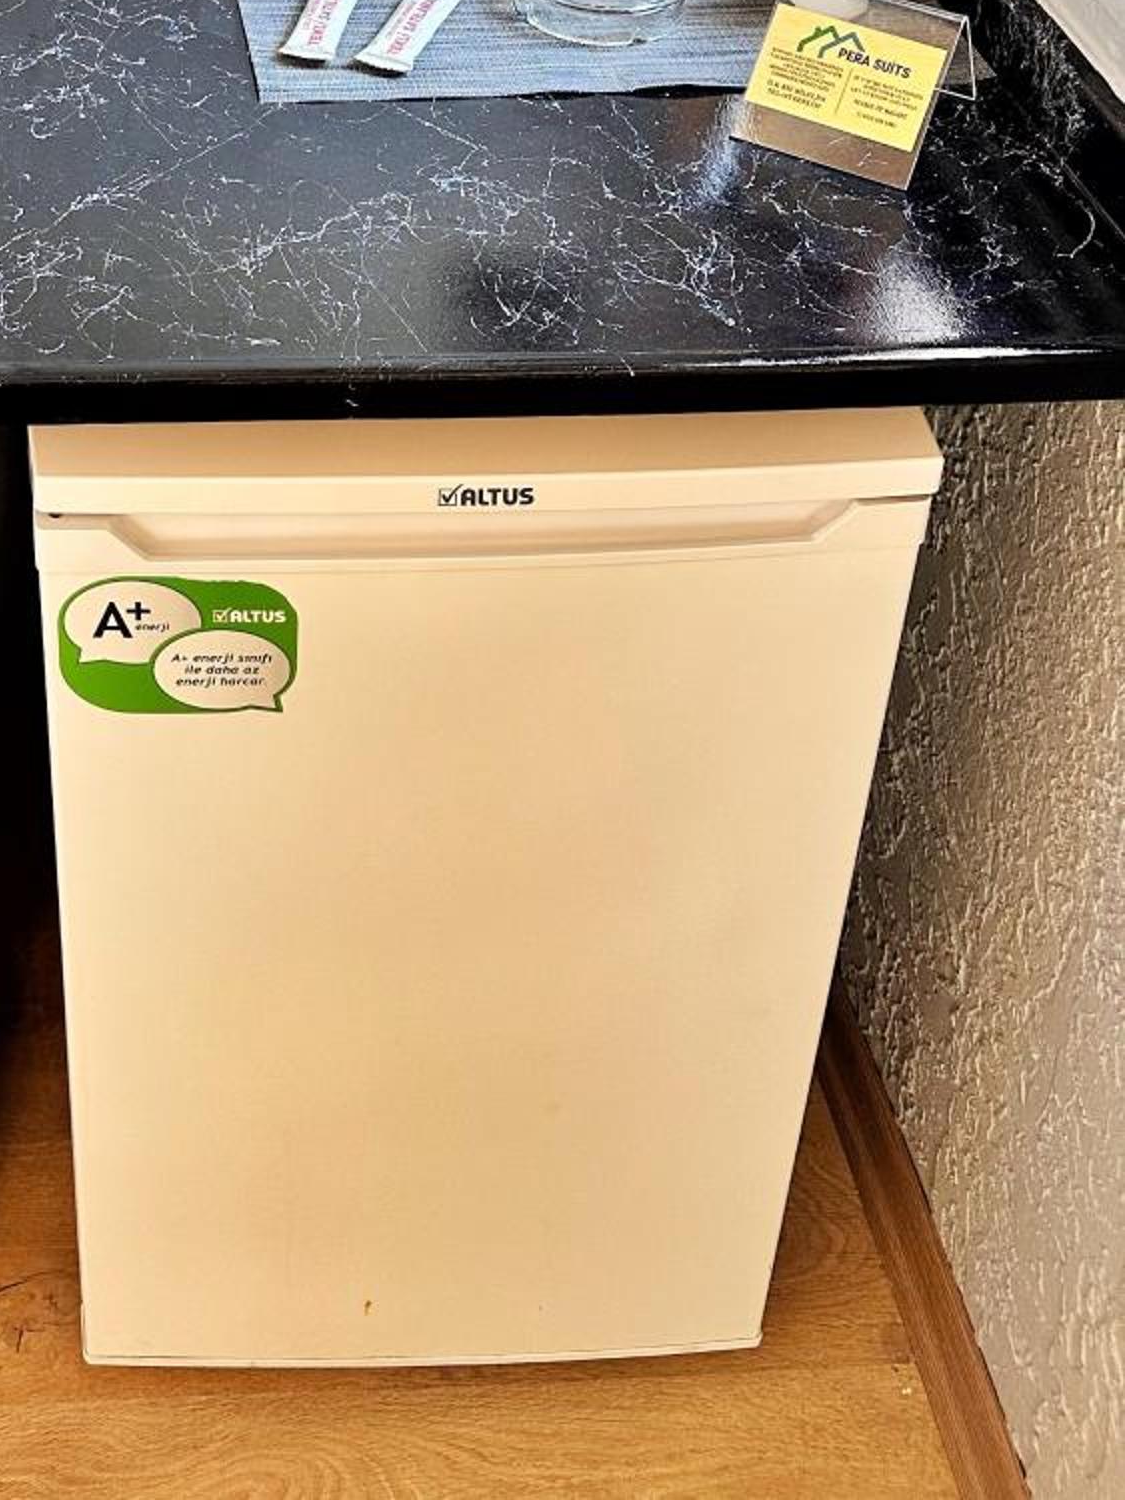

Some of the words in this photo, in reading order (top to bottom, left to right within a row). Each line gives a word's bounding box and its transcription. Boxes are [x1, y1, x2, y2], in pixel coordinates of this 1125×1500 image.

[837, 47, 870, 67] PERA
[460, 487, 535, 506] ALTUS
[93, 601, 151, 638] A+
[229, 610, 287, 623] ALTUS
[135, 622, 170, 633] enerji
[171, 654, 189, 663] A+
[192, 653, 235, 665] enerji
[184, 664, 202, 675] ile
[206, 664, 238, 675] daha
[243, 666, 260, 675] az
[176, 677, 217, 689] enerji
